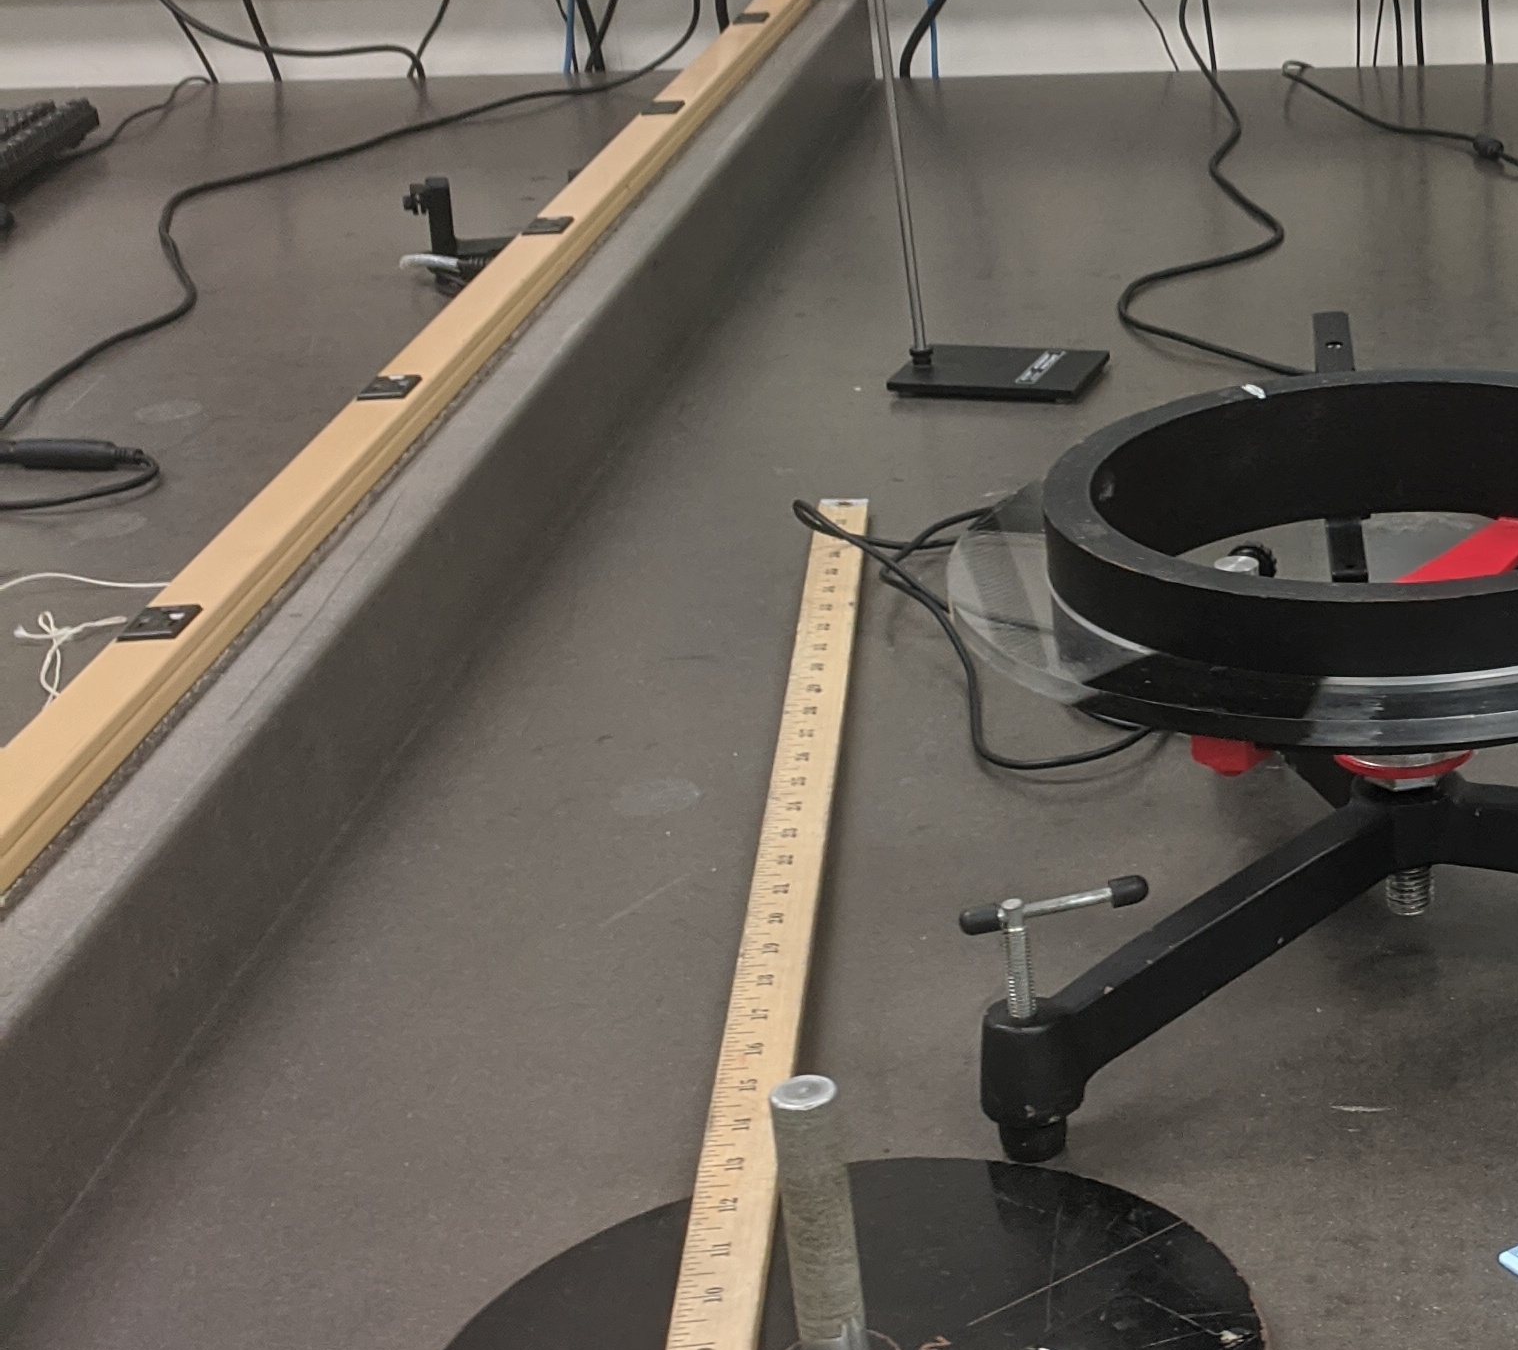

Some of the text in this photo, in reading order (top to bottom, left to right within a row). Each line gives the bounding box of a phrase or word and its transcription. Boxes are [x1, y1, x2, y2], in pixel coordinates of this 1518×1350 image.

[794, 752, 809, 761] 26
[790, 776, 806, 786] 25
[786, 801, 802, 811] 24
[781, 827, 797, 838] 23
[777, 855, 793, 865] 22
[772, 883, 790, 894] 21
[767, 913, 784, 924] 20
[762, 943, 779, 954] 19
[756, 974, 774, 986] 18
[751, 1008, 769, 1020] 17
[743, 1042, 764, 1055] 16
[738, 1079, 758, 1092] 15
[732, 1118, 752, 1131] 14
[724, 1157, 745, 1171] 13
[717, 1197, 738, 1213] 12
[711, 1242, 731, 1257] 11
[703, 1287, 724, 1304] 10
